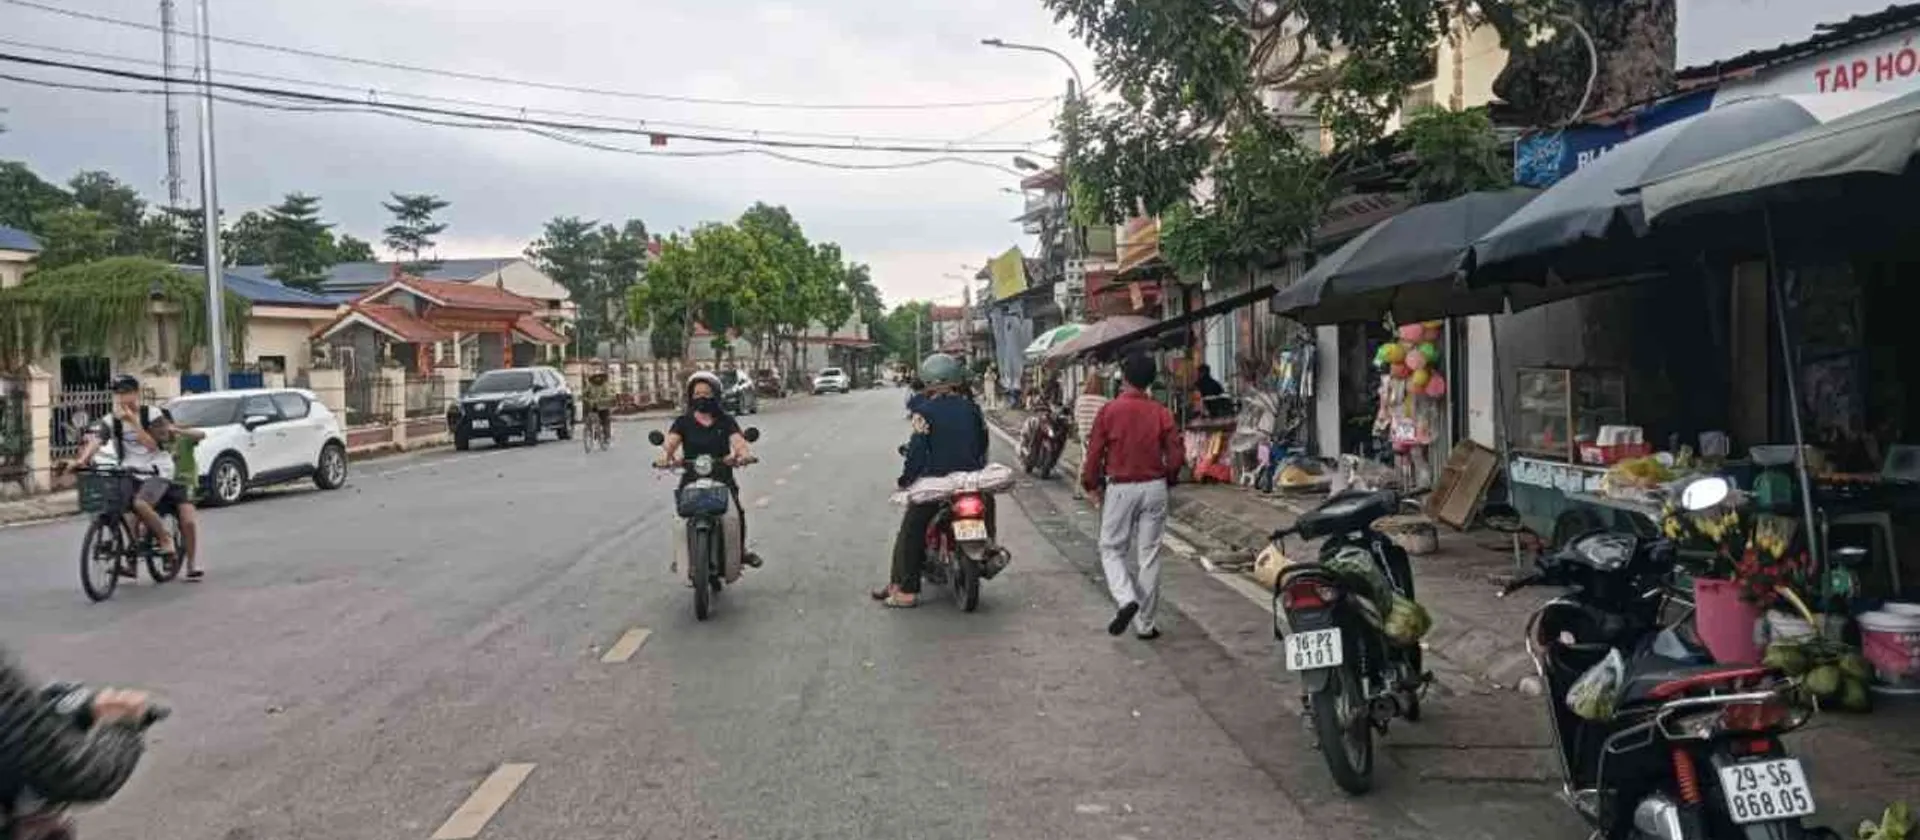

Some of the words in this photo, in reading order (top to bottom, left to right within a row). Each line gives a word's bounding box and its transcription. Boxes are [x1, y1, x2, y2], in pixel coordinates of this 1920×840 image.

[1875, 34, 1920, 82] HÓ
[1295, 648, 1333, 667] 0101
[1731, 763, 1791, 791] 29-S6
[1733, 787, 1807, 818] 868.05
